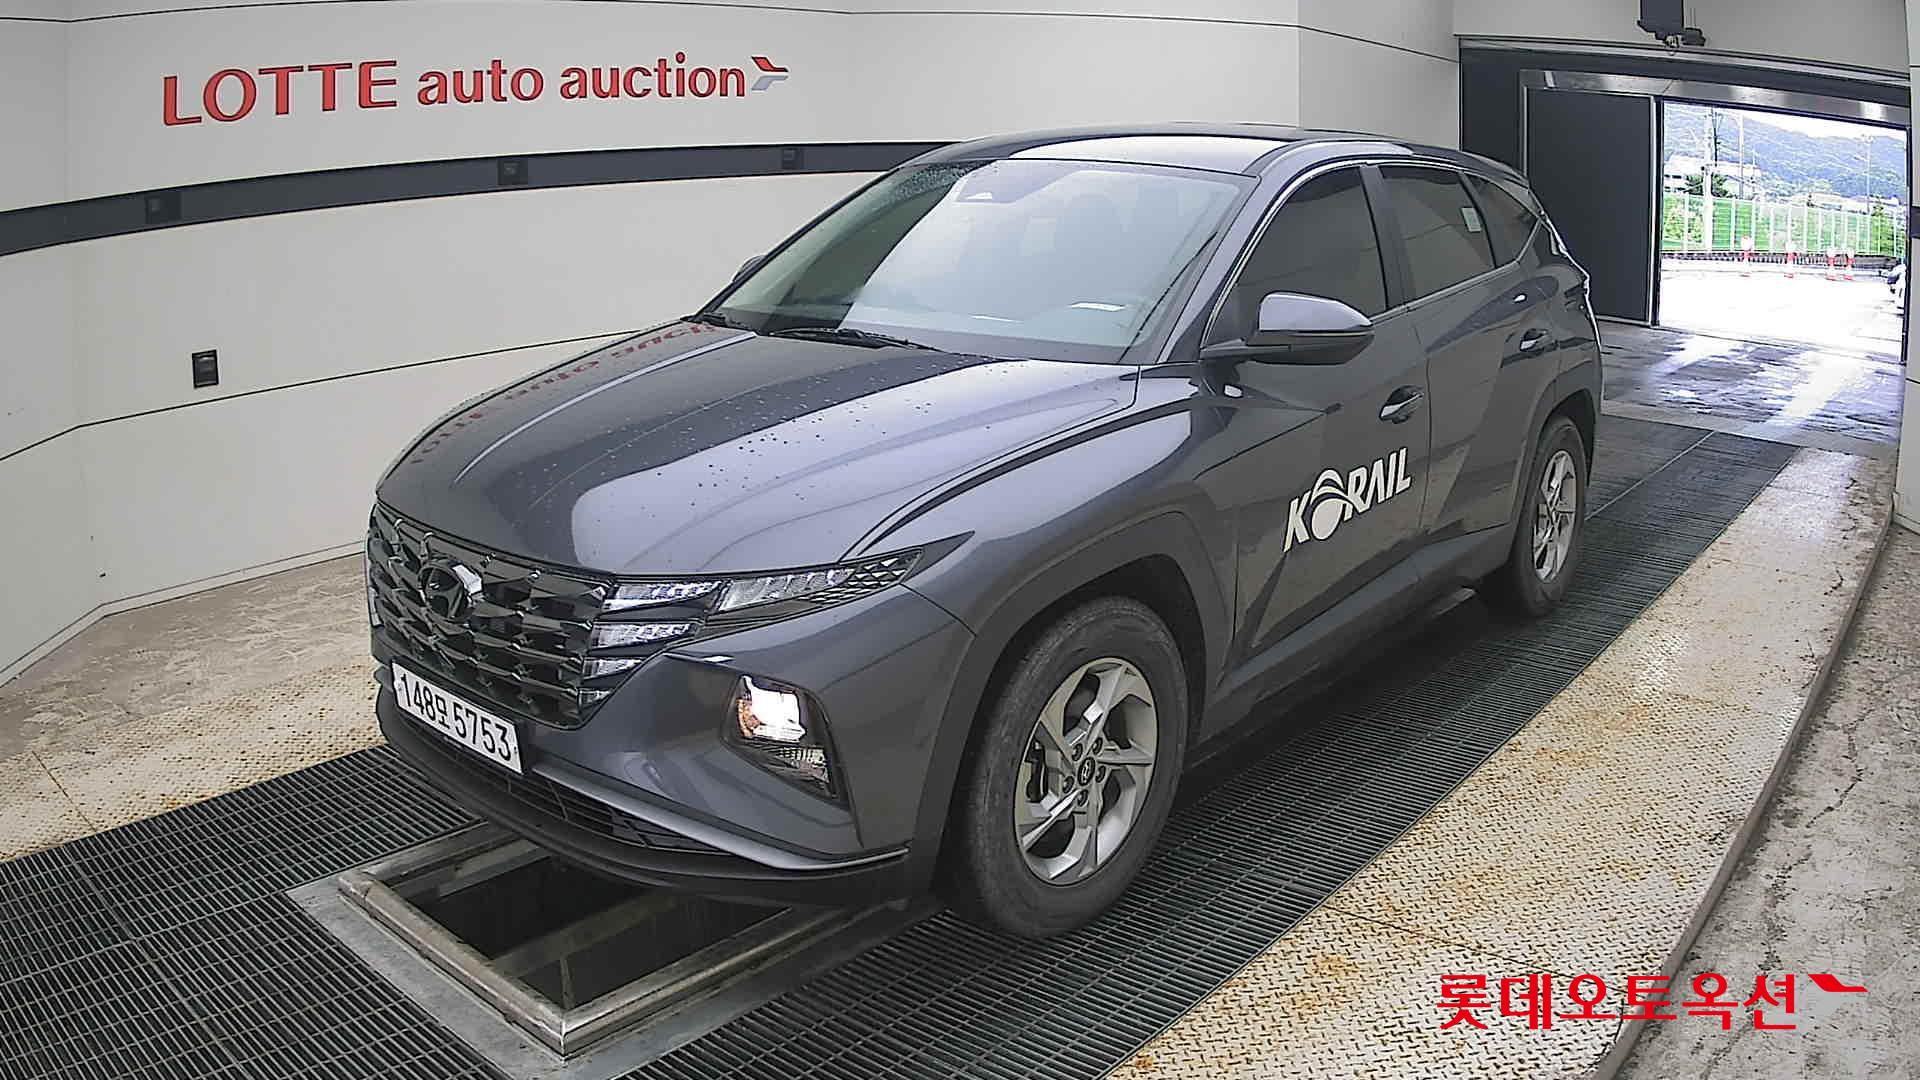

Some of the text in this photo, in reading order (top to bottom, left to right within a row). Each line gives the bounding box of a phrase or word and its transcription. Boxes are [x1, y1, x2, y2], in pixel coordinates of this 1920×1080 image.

[162, 51, 746, 126] LOTTE auto auction
[1283, 447, 1412, 553] KORAIL
